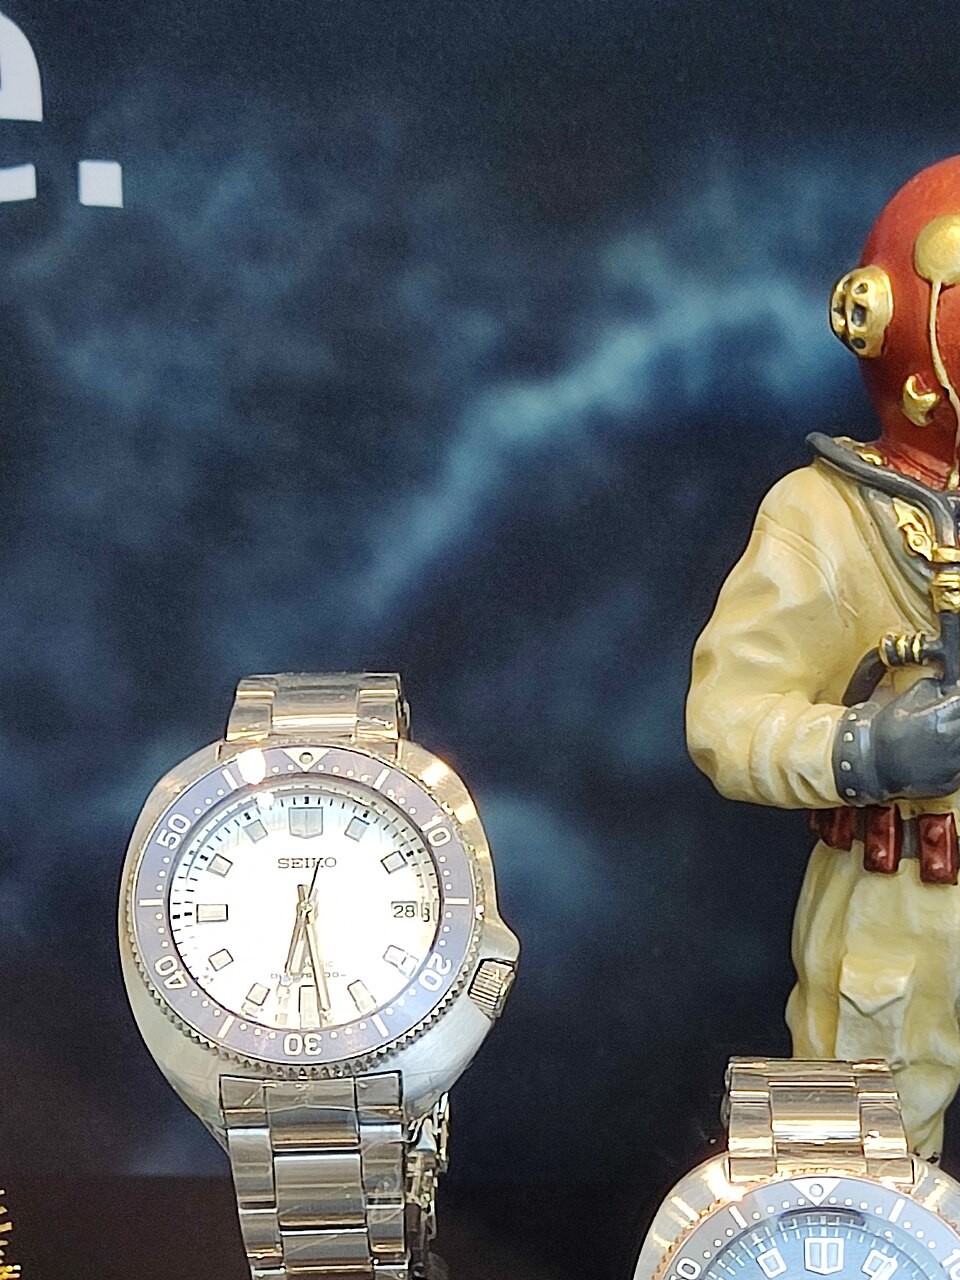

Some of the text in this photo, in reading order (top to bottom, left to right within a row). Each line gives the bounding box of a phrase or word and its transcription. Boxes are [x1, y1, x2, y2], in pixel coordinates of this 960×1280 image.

[156, 813, 192, 851] 50
[421, 814, 452, 848] 10
[278, 857, 337, 869] SEIKO
[393, 905, 416, 918] 28
[155, 954, 188, 991] 40
[418, 956, 453, 991] 20
[283, 1032, 323, 1057] 30
